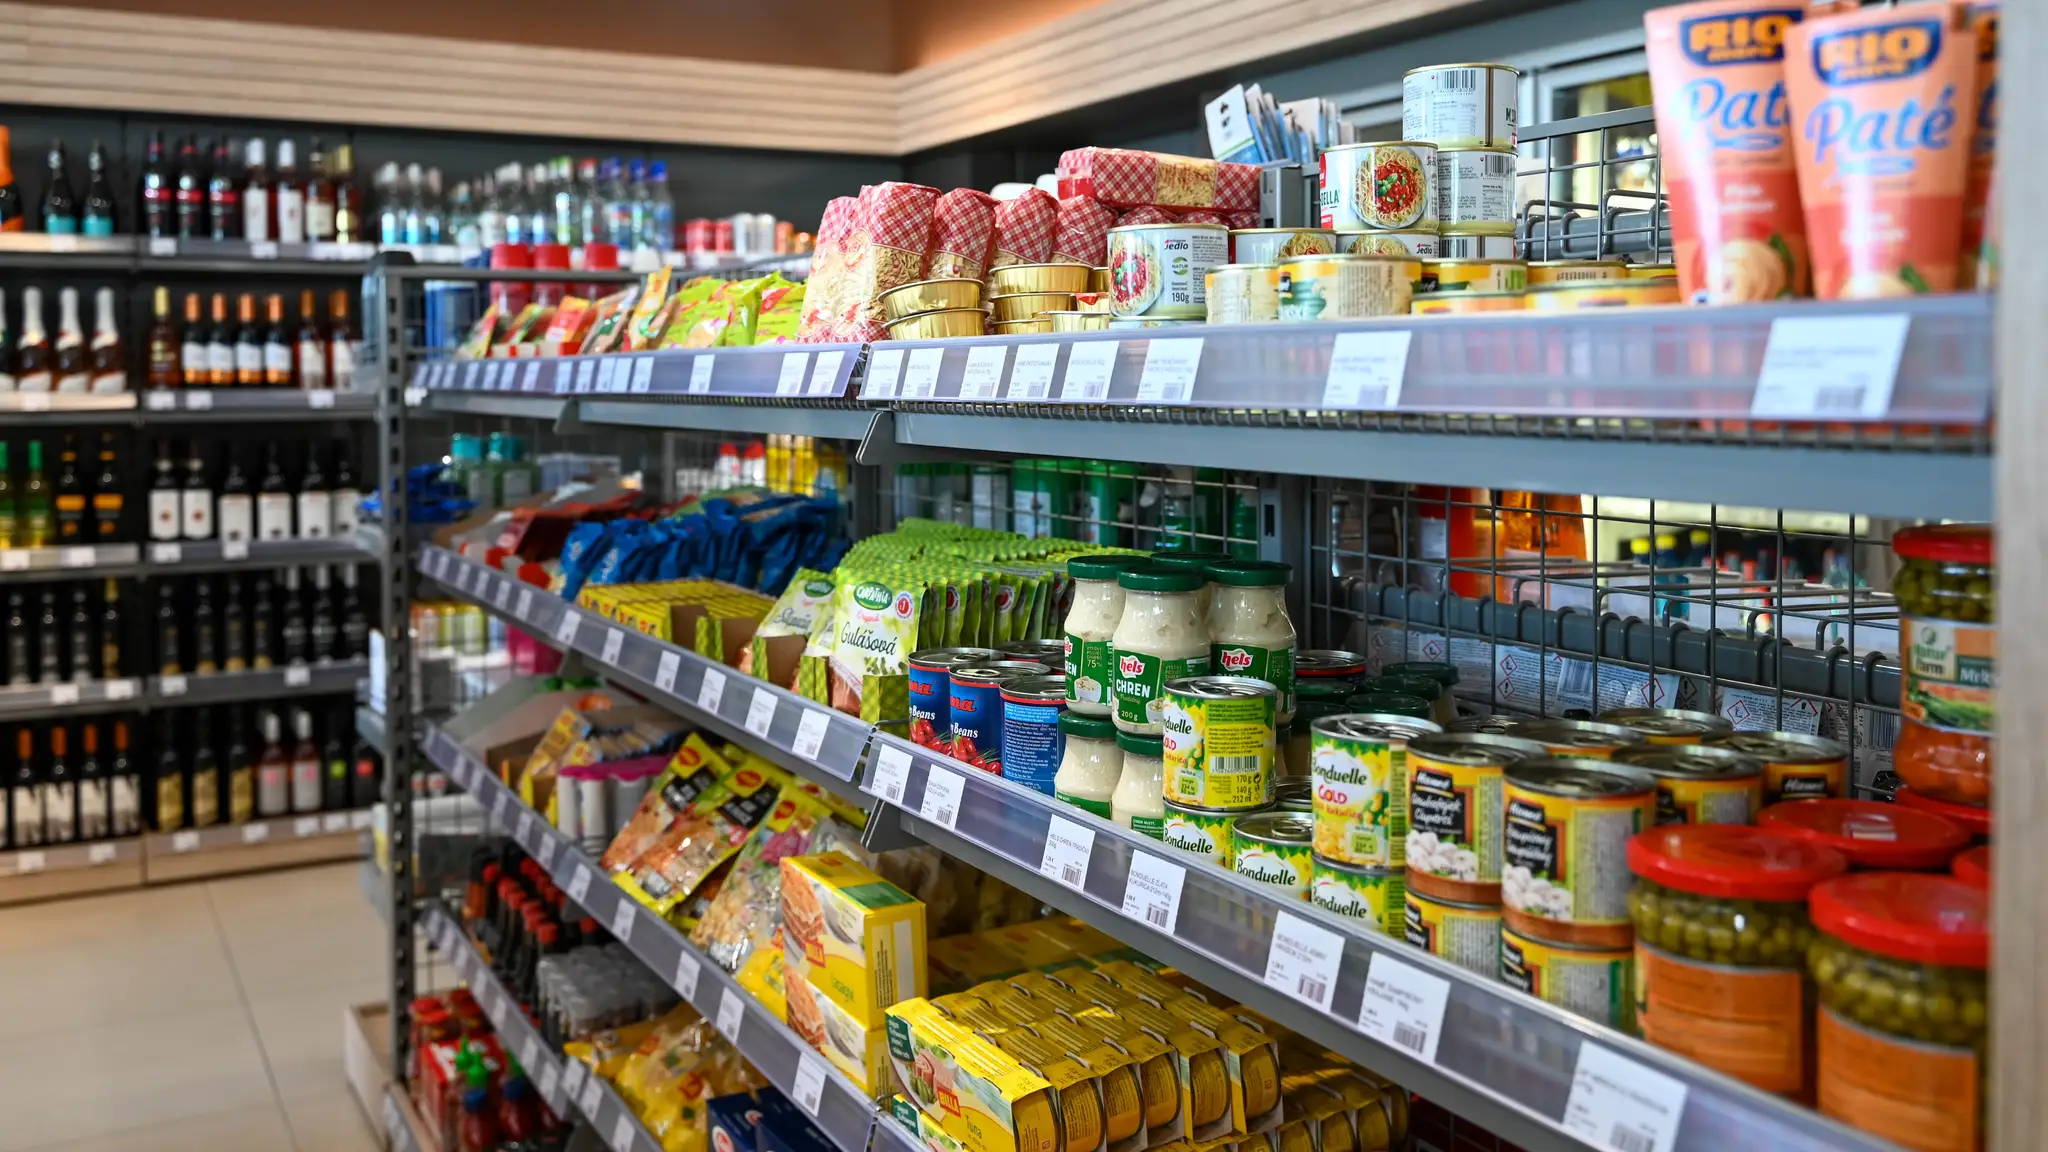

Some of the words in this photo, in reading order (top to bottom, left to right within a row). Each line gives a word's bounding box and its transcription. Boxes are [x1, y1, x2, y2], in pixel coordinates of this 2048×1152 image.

[1689, 15, 1790, 52] RIO
[1171, 292, 1190, 304] 190g
[840, 621, 898, 656] Gulášová
[1120, 657, 1143, 674] hels
[1222, 651, 1251, 667] hels
[1115, 679, 1151, 698] CHREN
[1236, 775, 1248, 783] 170
[1236, 785, 1248, 793] 140
[1236, 858, 1296, 886] Bonduelle
